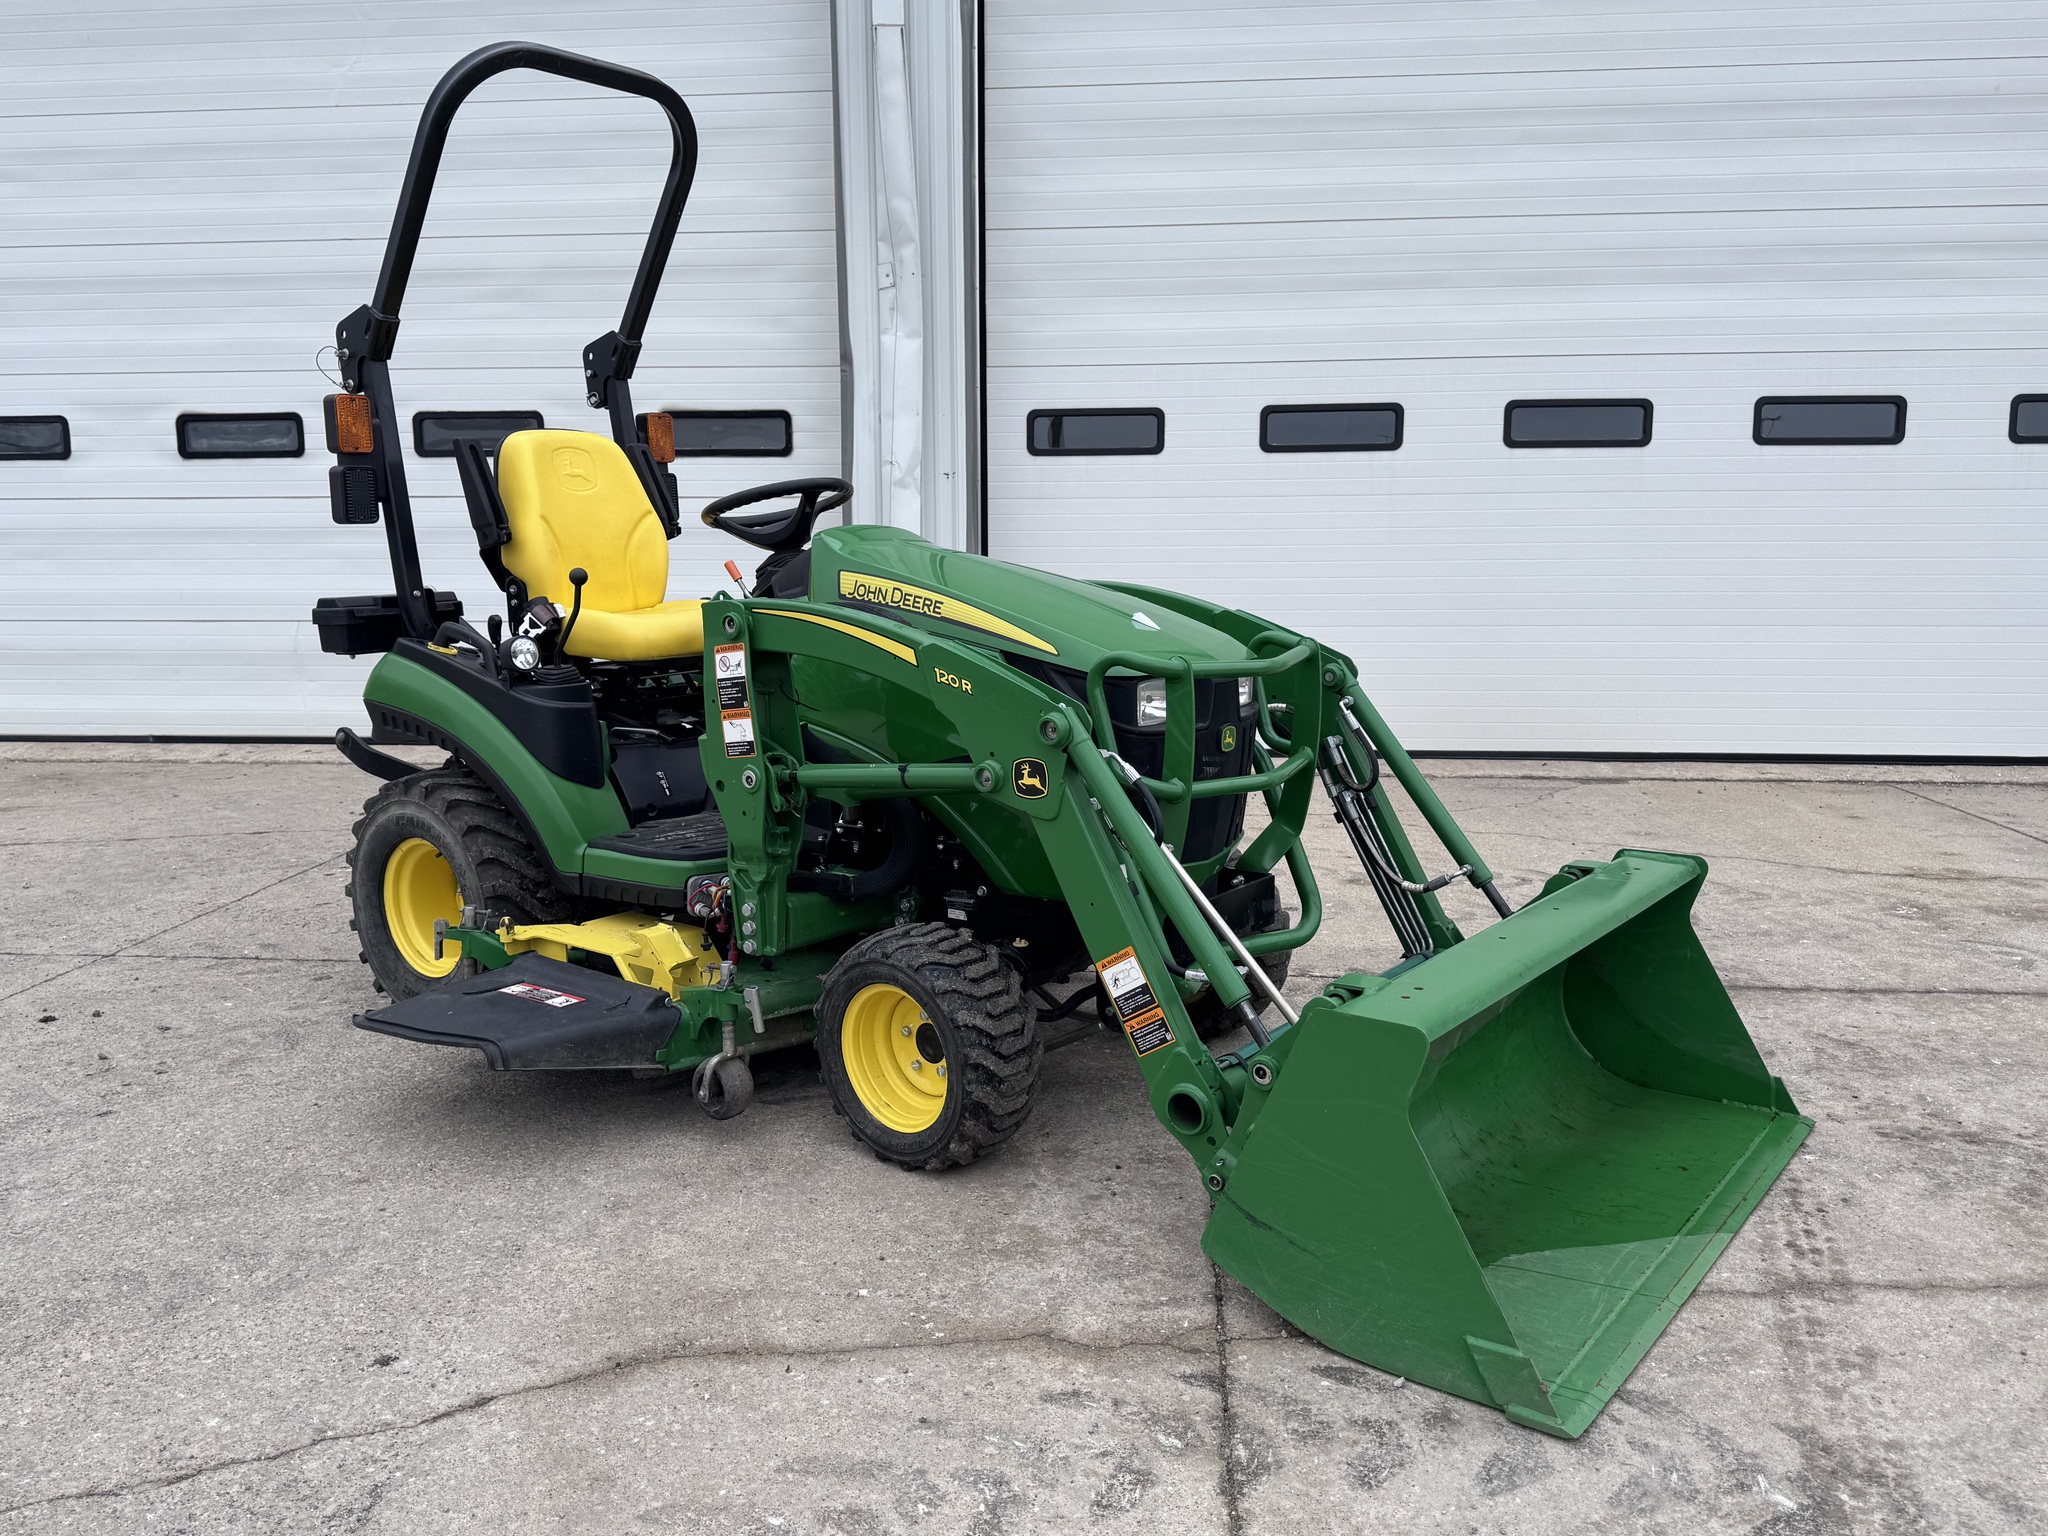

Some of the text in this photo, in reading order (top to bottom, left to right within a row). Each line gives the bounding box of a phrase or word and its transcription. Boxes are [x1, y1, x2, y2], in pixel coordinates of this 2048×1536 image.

[848, 580, 944, 616] JOHN DEERE
[720, 644, 743, 652] WARNING
[726, 711, 750, 719] WARNING
[1107, 951, 1130, 965] WARNING
[1135, 1012, 1160, 1026] WARNING
